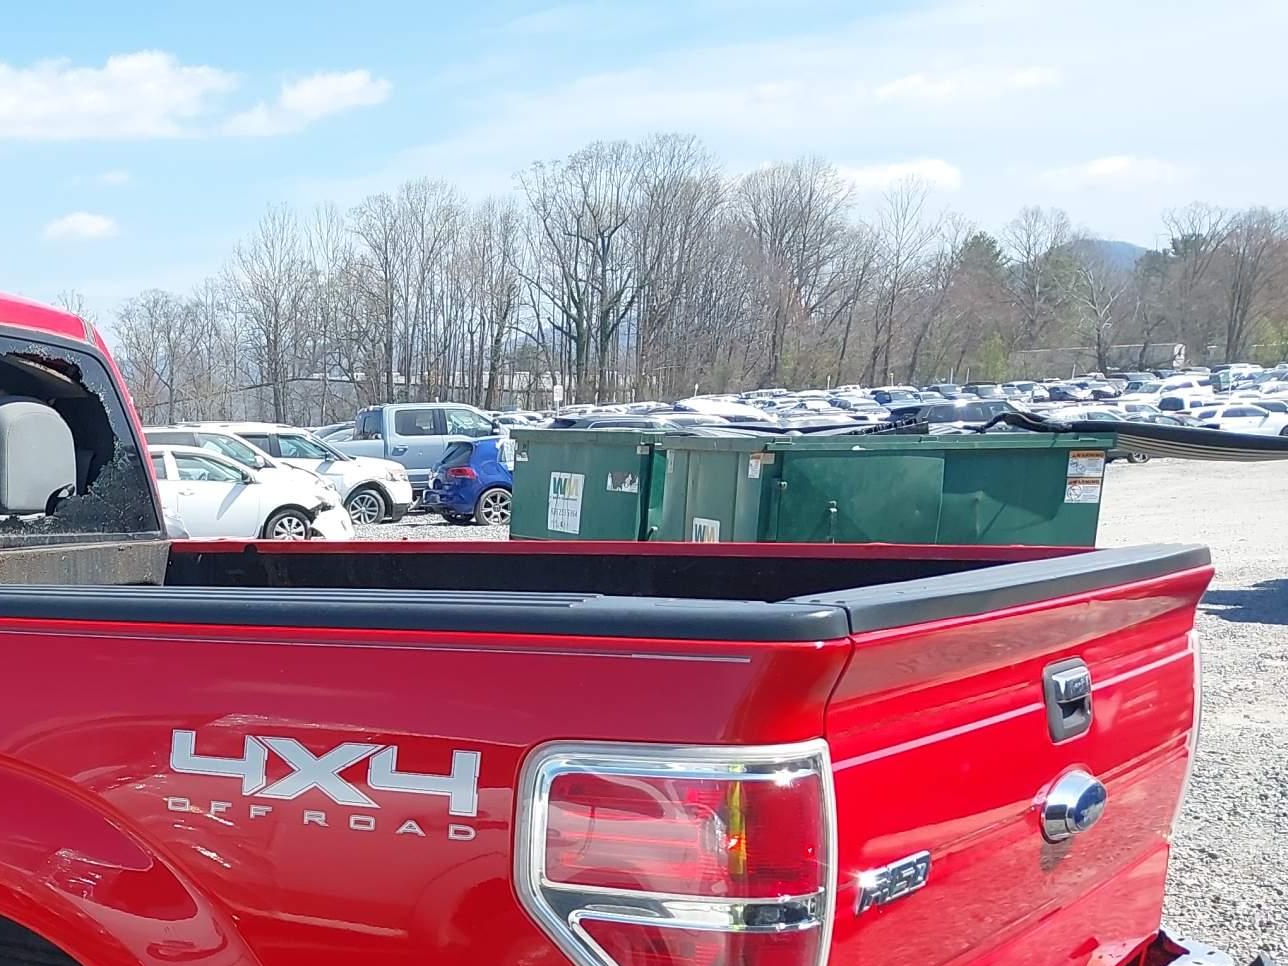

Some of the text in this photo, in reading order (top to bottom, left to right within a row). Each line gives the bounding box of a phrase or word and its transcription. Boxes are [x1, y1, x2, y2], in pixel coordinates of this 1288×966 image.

[553, 477, 579, 496] WM
[167, 796, 477, 841] OFF ROAD
